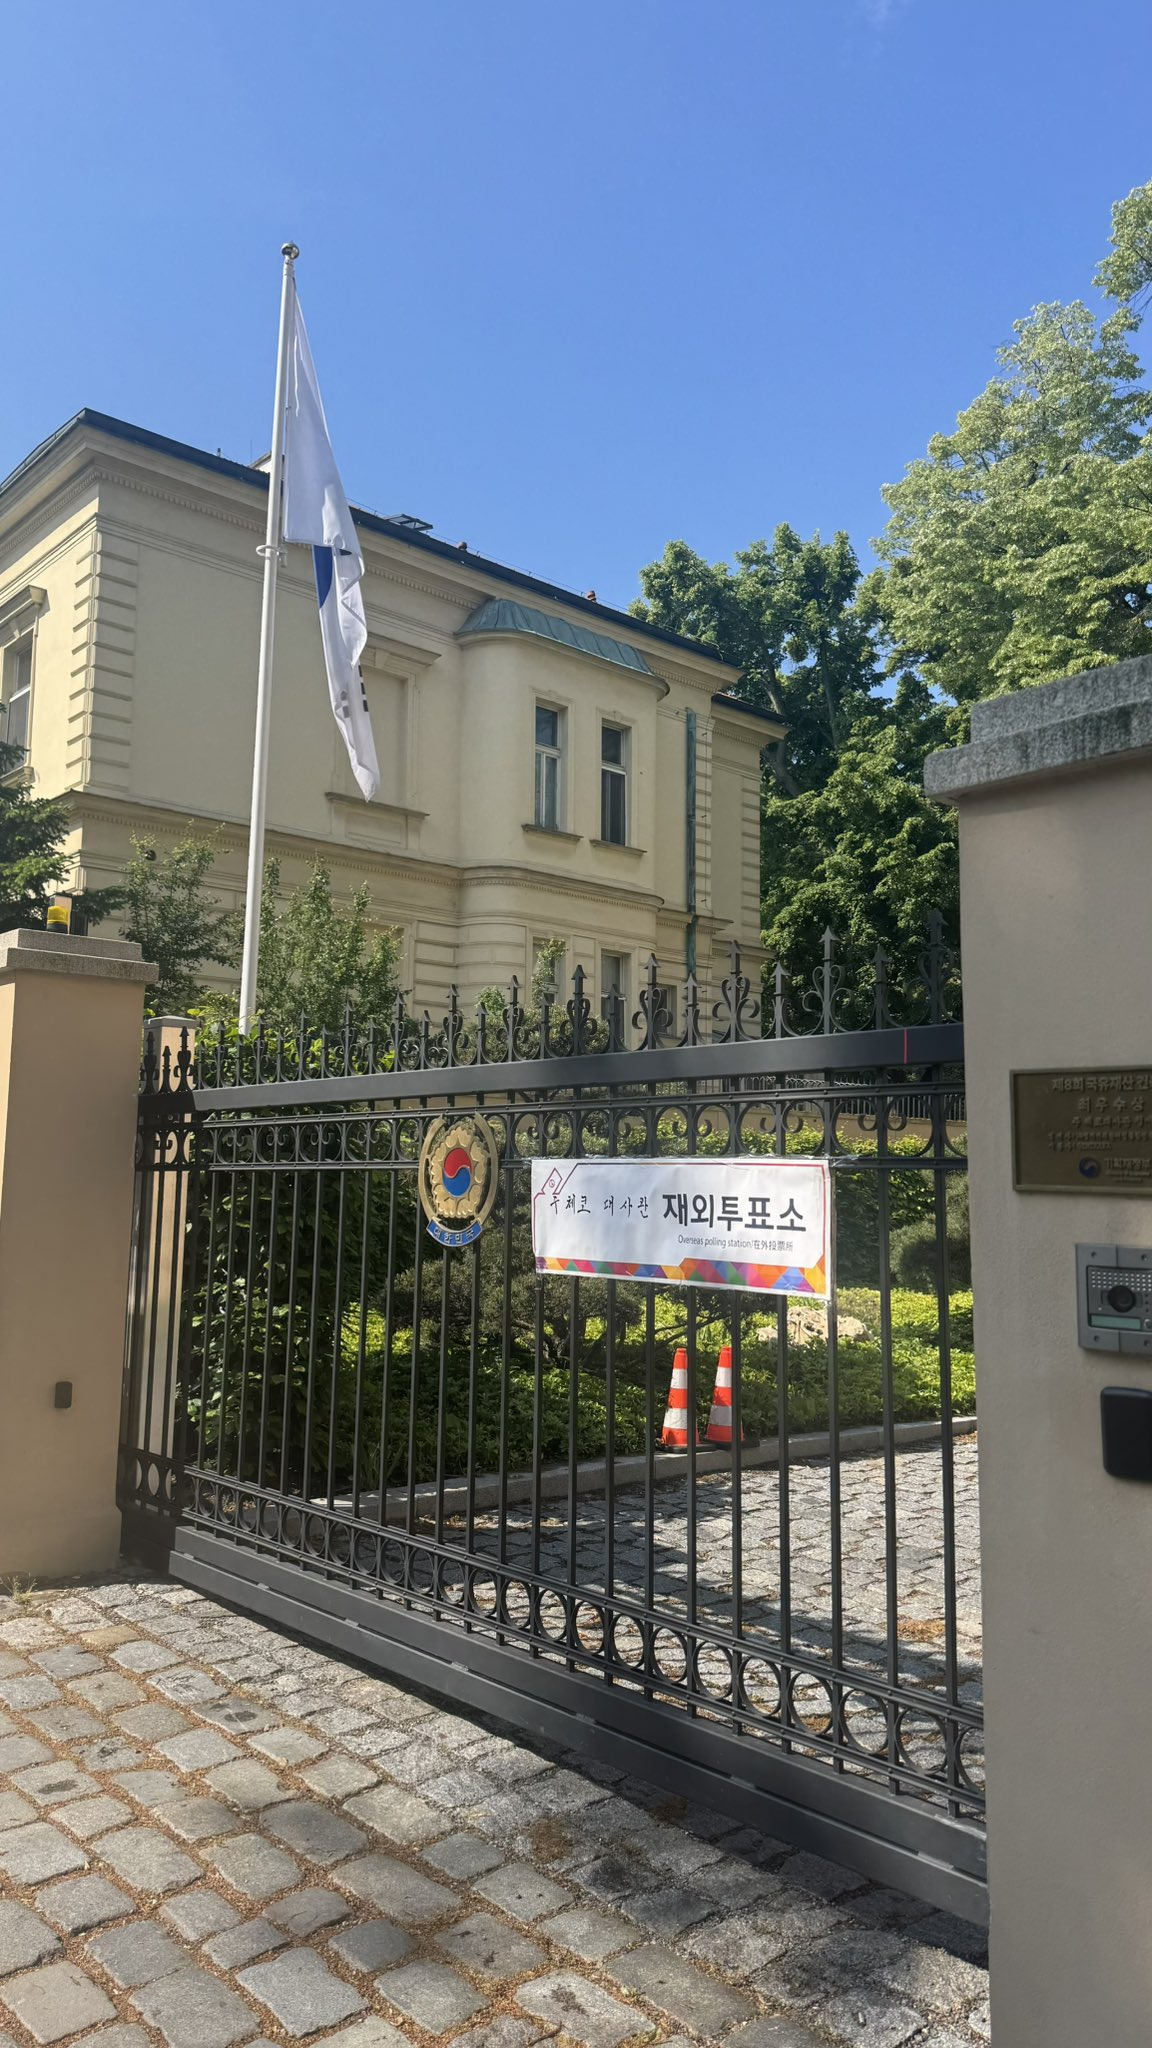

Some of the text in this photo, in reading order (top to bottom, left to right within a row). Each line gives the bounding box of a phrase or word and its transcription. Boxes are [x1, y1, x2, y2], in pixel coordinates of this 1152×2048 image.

[550, 1193, 806, 1232] 주체코 대사관 재외투표소
[433, 1226, 474, 1244] 대한민국
[678, 1234, 704, 1245] Overseas
[705, 1237, 726, 1249] polling
